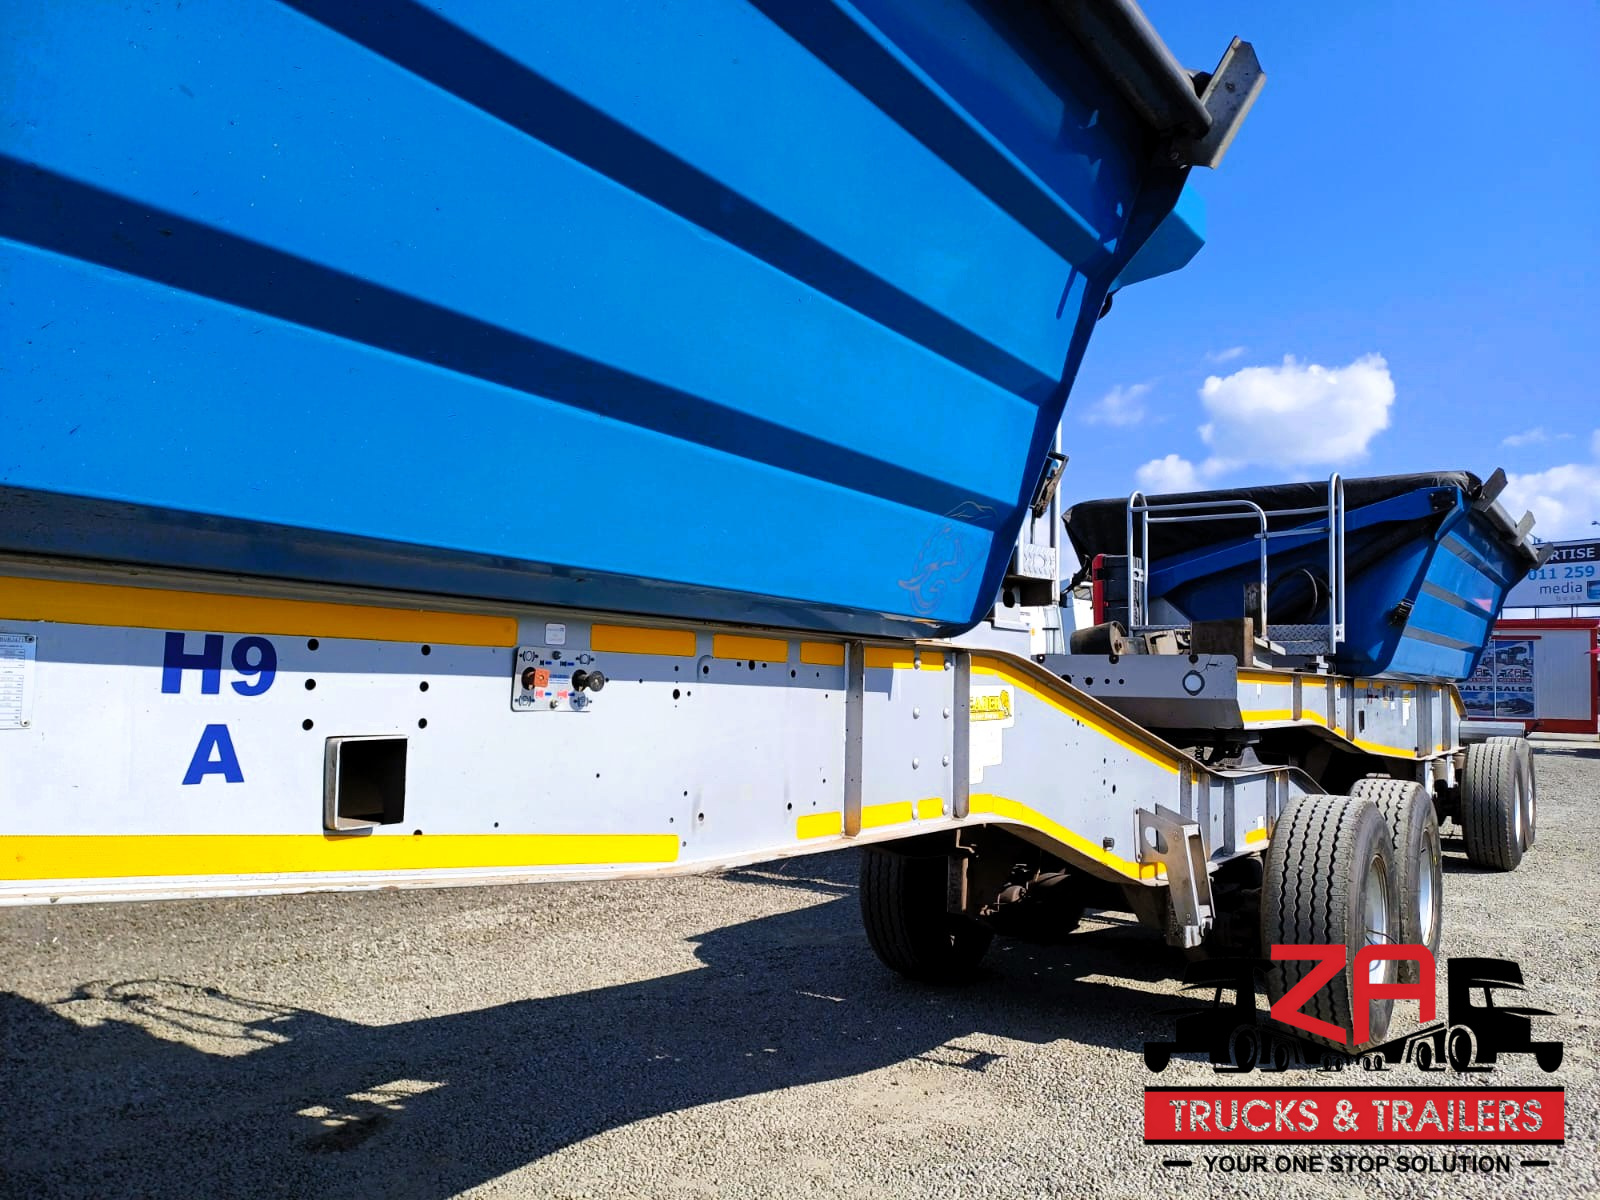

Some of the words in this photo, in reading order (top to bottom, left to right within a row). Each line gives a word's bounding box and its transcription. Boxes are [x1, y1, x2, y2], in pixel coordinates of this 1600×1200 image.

[1528, 568, 1556, 580] 011
[1564, 565, 1595, 578] 259
[1540, 581, 1582, 594] media
[162, 632, 277, 696] H9
[182, 724, 245, 785] A
